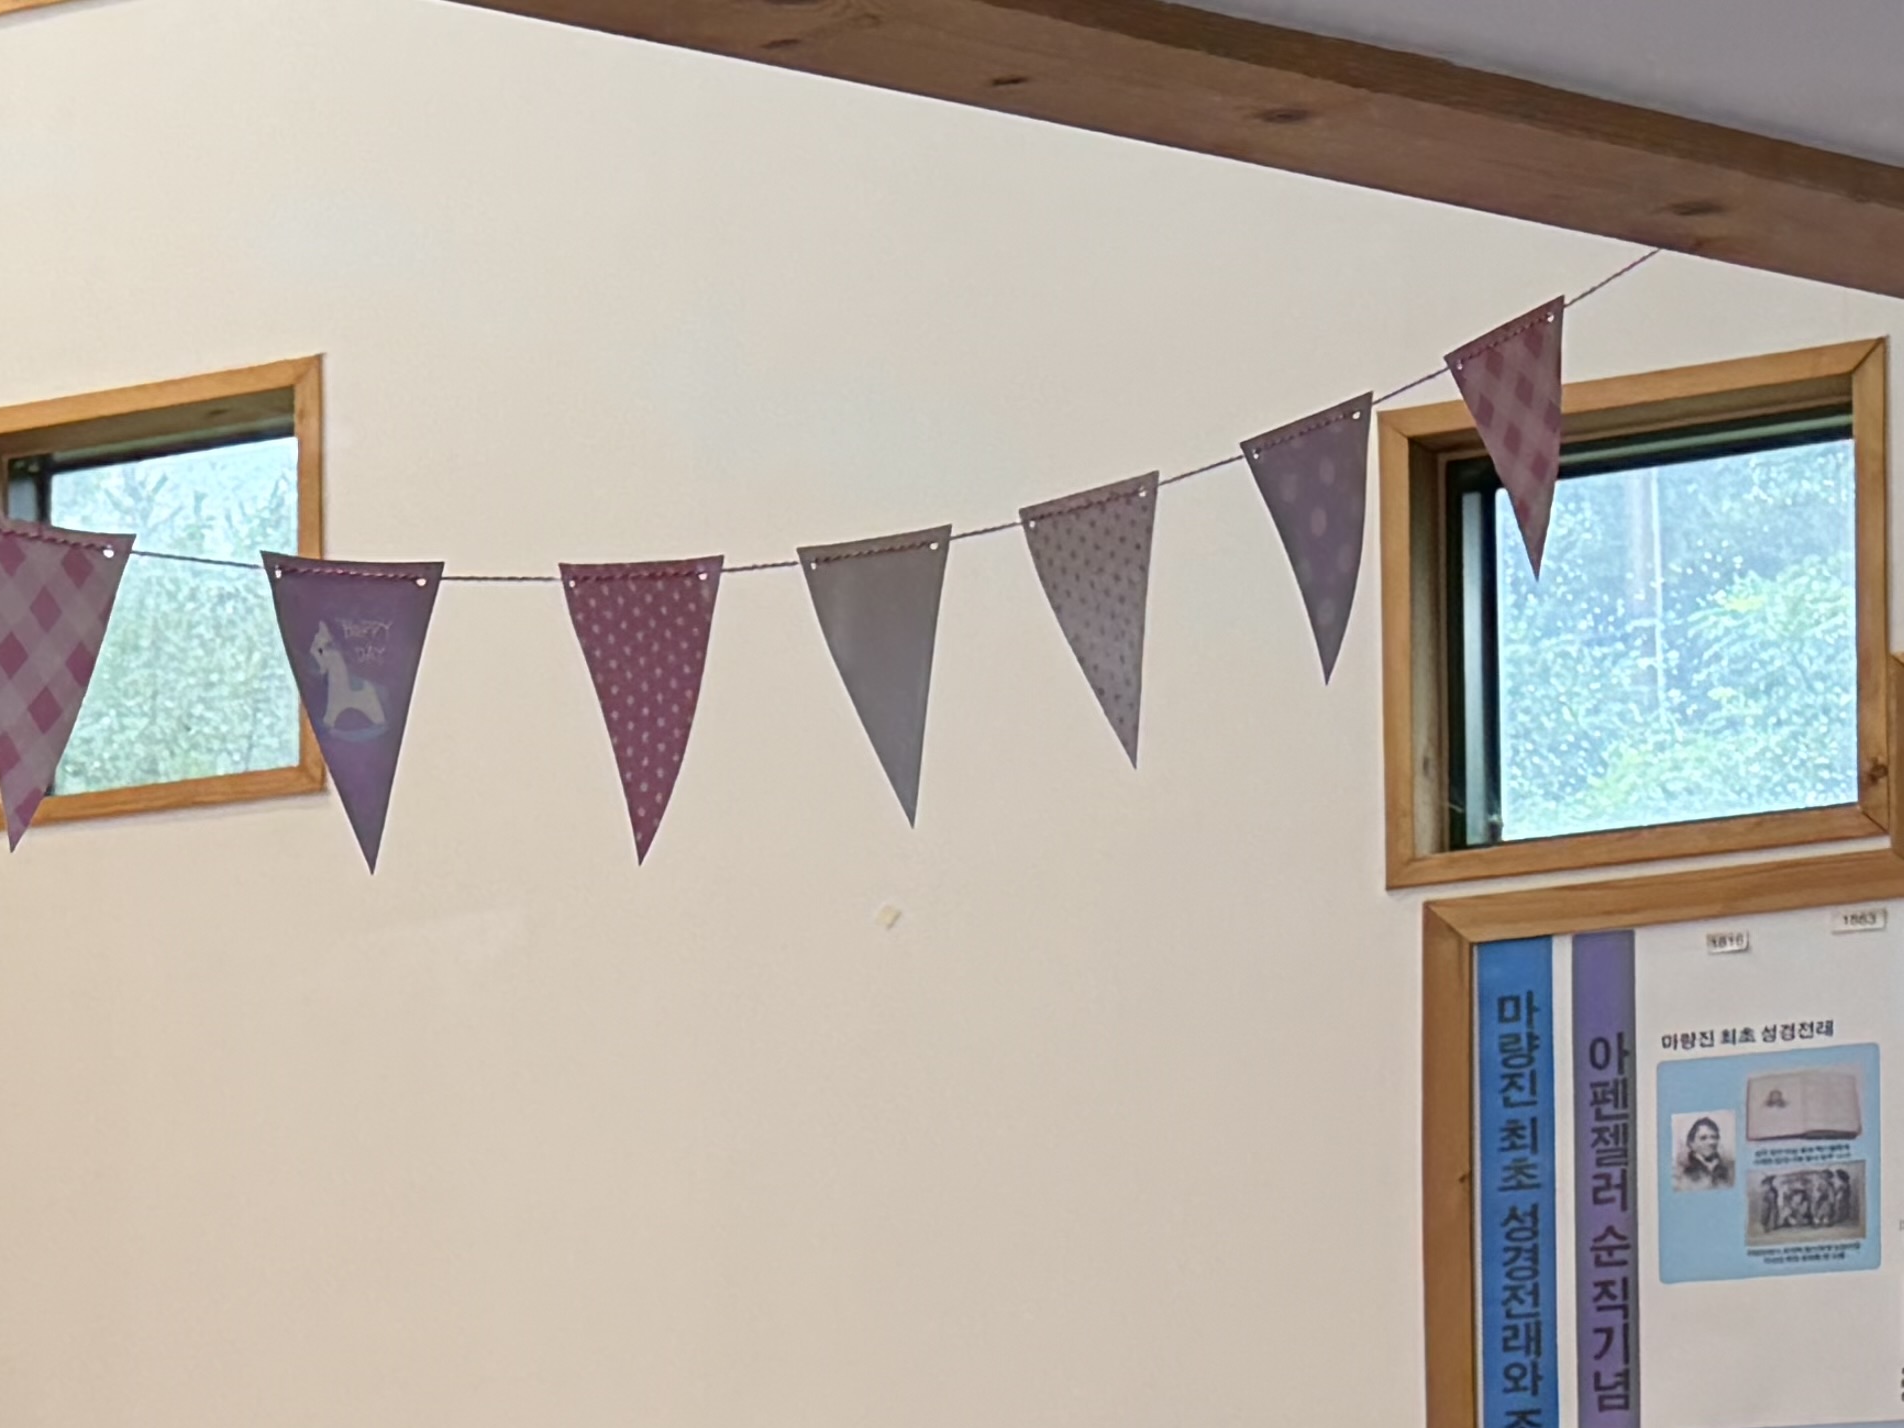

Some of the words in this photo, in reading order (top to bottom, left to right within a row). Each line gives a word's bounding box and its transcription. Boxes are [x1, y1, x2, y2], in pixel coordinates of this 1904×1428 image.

[1496, 990, 1539, 1110] 마량진
[1588, 1032, 1631, 1212] 아펜젤러
[1497, 1116, 1542, 1194] 최초
[1498, 1203, 1544, 1398] 성경전래와
